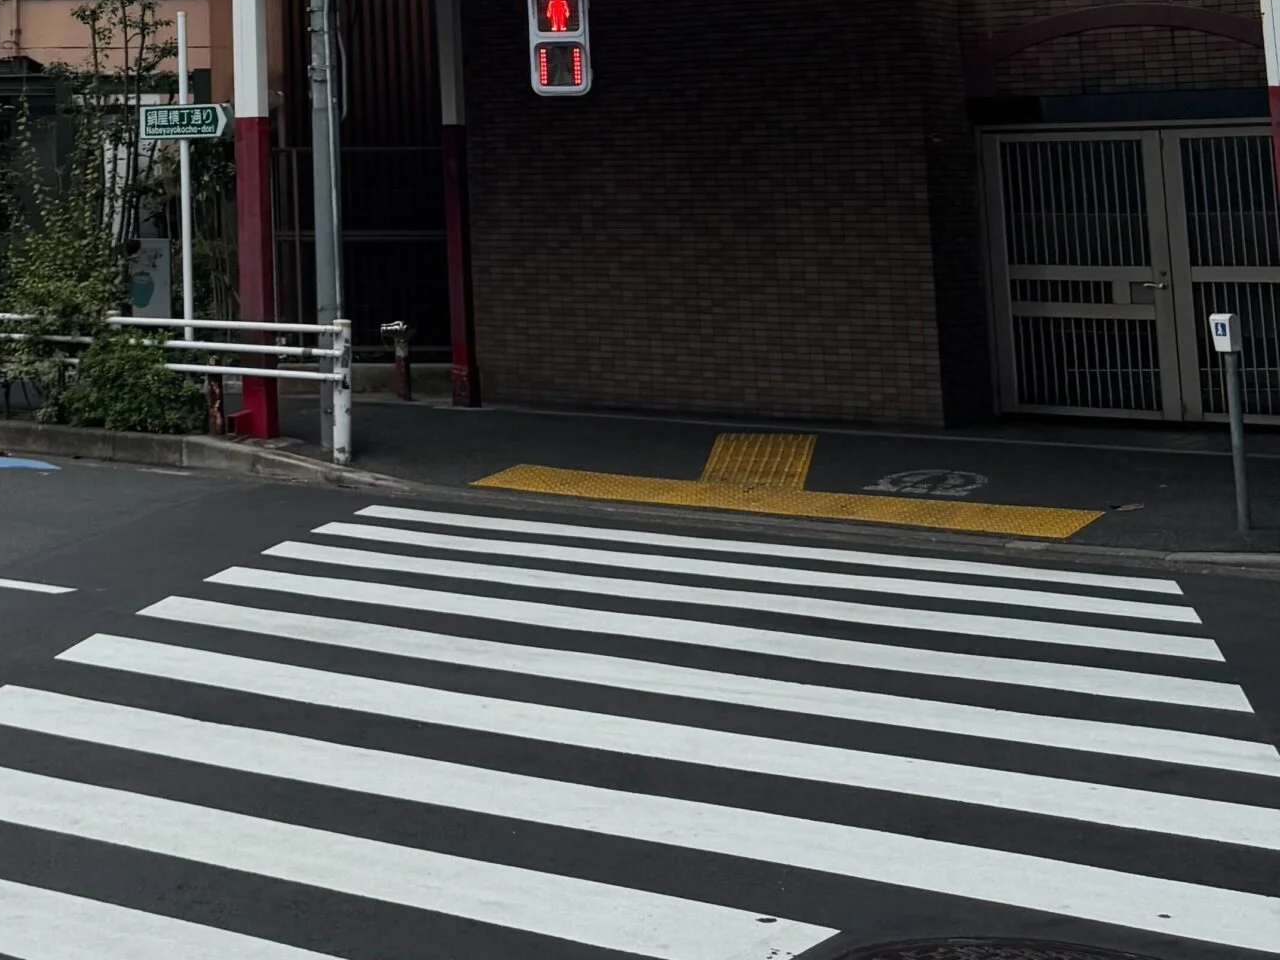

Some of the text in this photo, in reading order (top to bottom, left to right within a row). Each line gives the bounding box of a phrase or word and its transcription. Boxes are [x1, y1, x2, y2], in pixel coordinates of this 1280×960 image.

[146, 109, 213, 126] 鍋屋横丁通り
